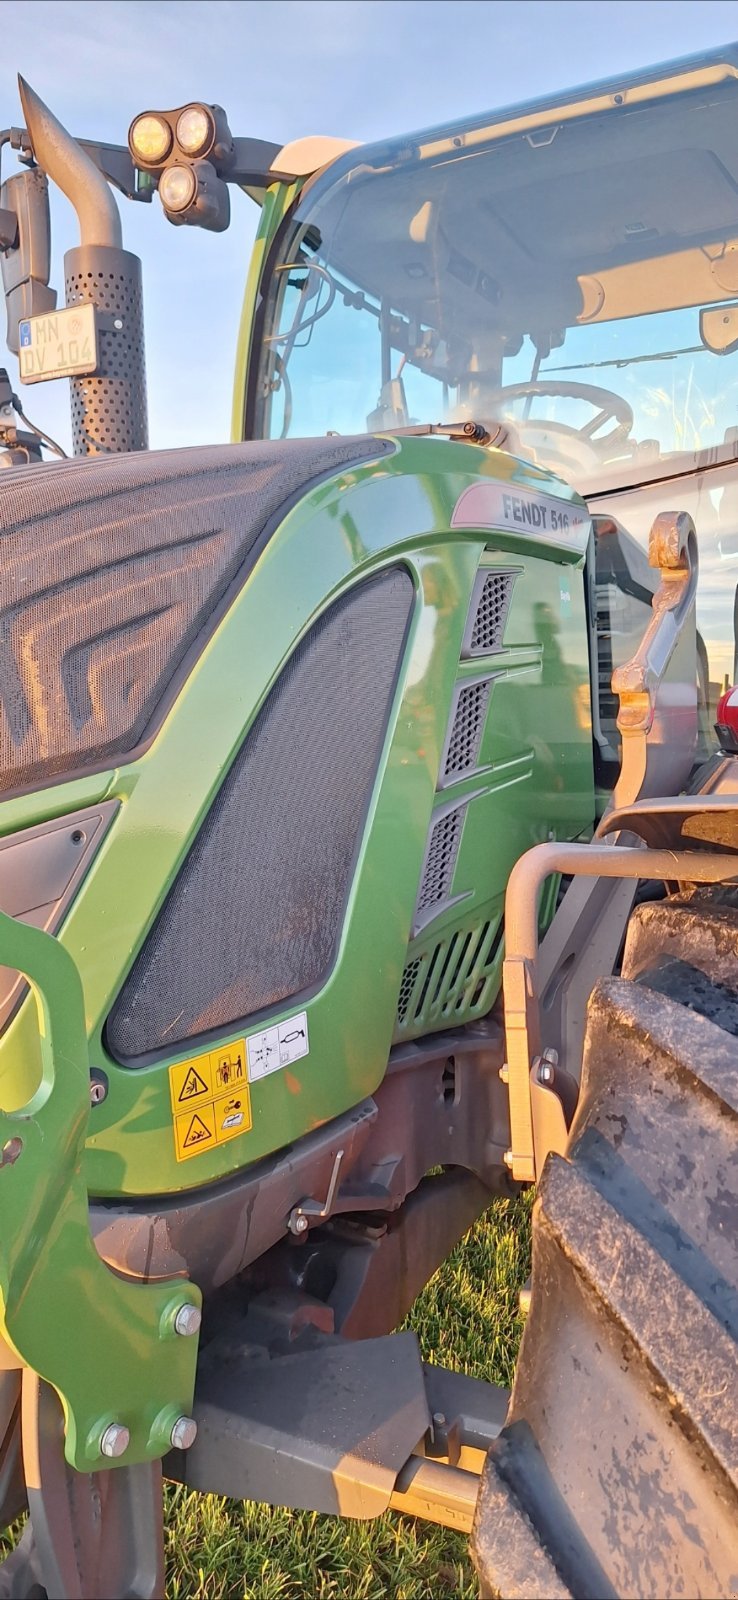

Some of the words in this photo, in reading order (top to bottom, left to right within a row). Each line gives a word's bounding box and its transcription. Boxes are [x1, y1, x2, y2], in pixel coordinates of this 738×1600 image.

[35, 317, 59, 345] MN
[24, 347, 46, 374] DV
[57, 336, 92, 367] 104
[502, 494, 547, 529] FENDT
[550, 510, 570, 536] 516
